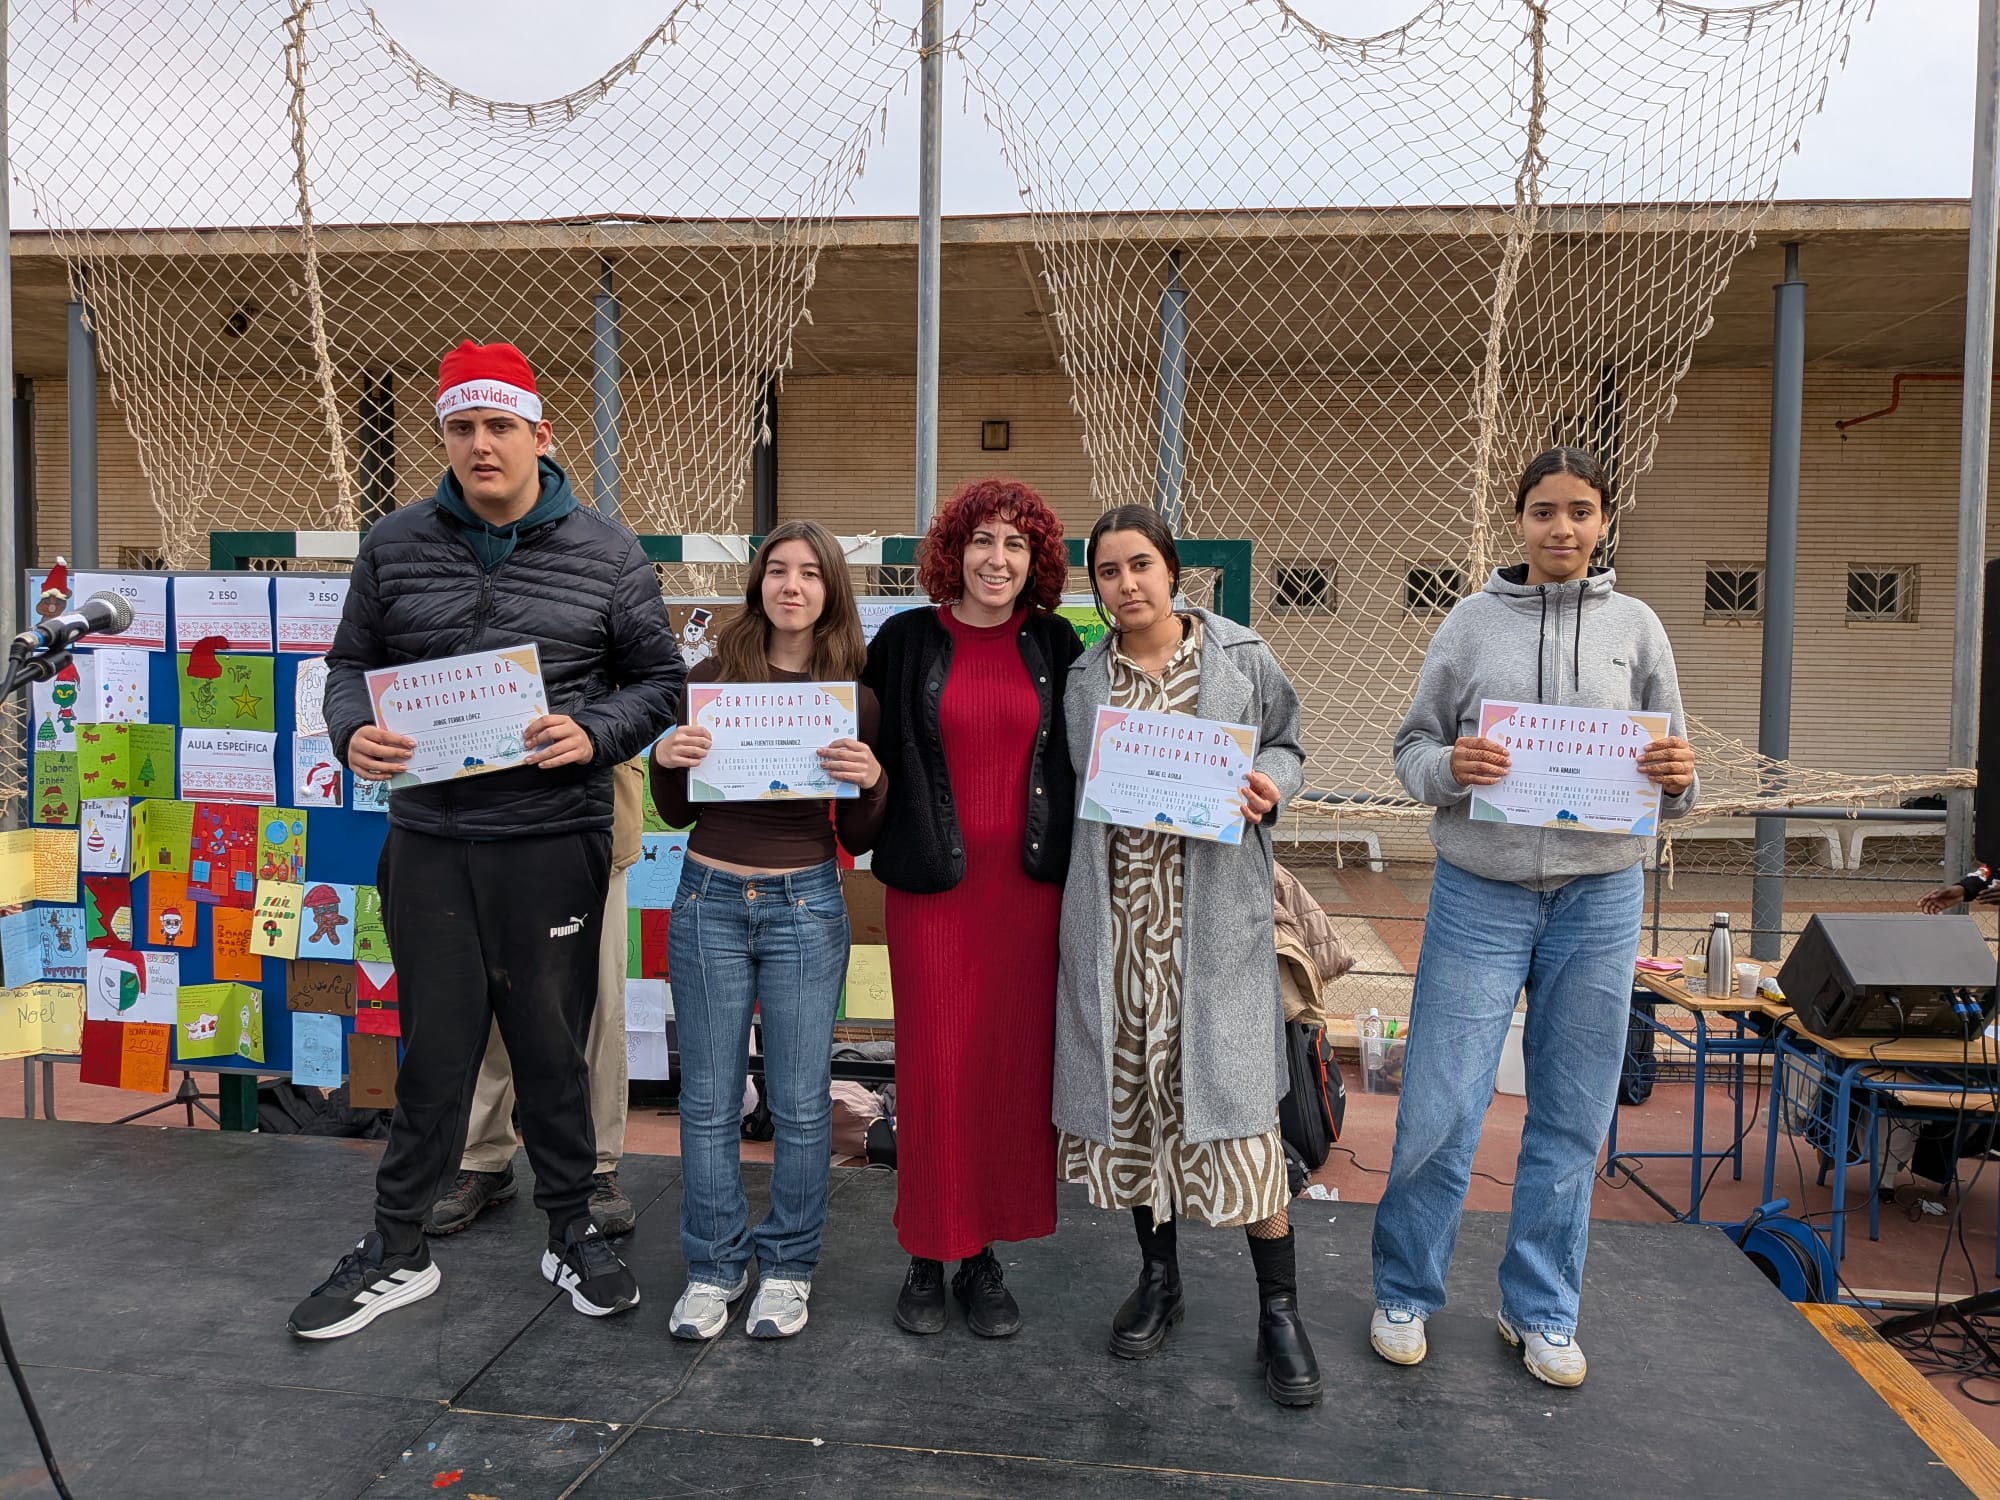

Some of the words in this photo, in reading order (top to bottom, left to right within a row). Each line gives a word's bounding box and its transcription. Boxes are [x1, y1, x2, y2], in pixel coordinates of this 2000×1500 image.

[460, 387, 518, 409] Navidad
[120, 588, 138, 596] ESO
[208, 590, 214, 600] 2
[219, 590, 238, 600] ESO
[308, 592, 316, 600] 3
[319, 592, 339, 602] ESO
[393, 665, 484, 692] CERTIFICAT
[494, 660, 512, 674] DE
[396, 681, 518, 712] PARTICIPATION
[716, 694, 804, 708] CERTIFICAT
[814, 694, 830, 706] DE
[715, 714, 832, 728] PARTICIPATION
[1508, 714, 1608, 734] CERTIFICAT
[1621, 724, 1639, 737] DE
[1120, 720, 1204, 743] CERTIFICAT
[1213, 733, 1230, 747] DE
[188, 740, 214, 750] AULA
[218, 740, 268, 752] ESPECÍFICA
[1115, 740, 1228, 768] PARTICIPATION
[1505, 736, 1638, 758] PARTICIPATION
[550, 924, 580, 938] PUMA
